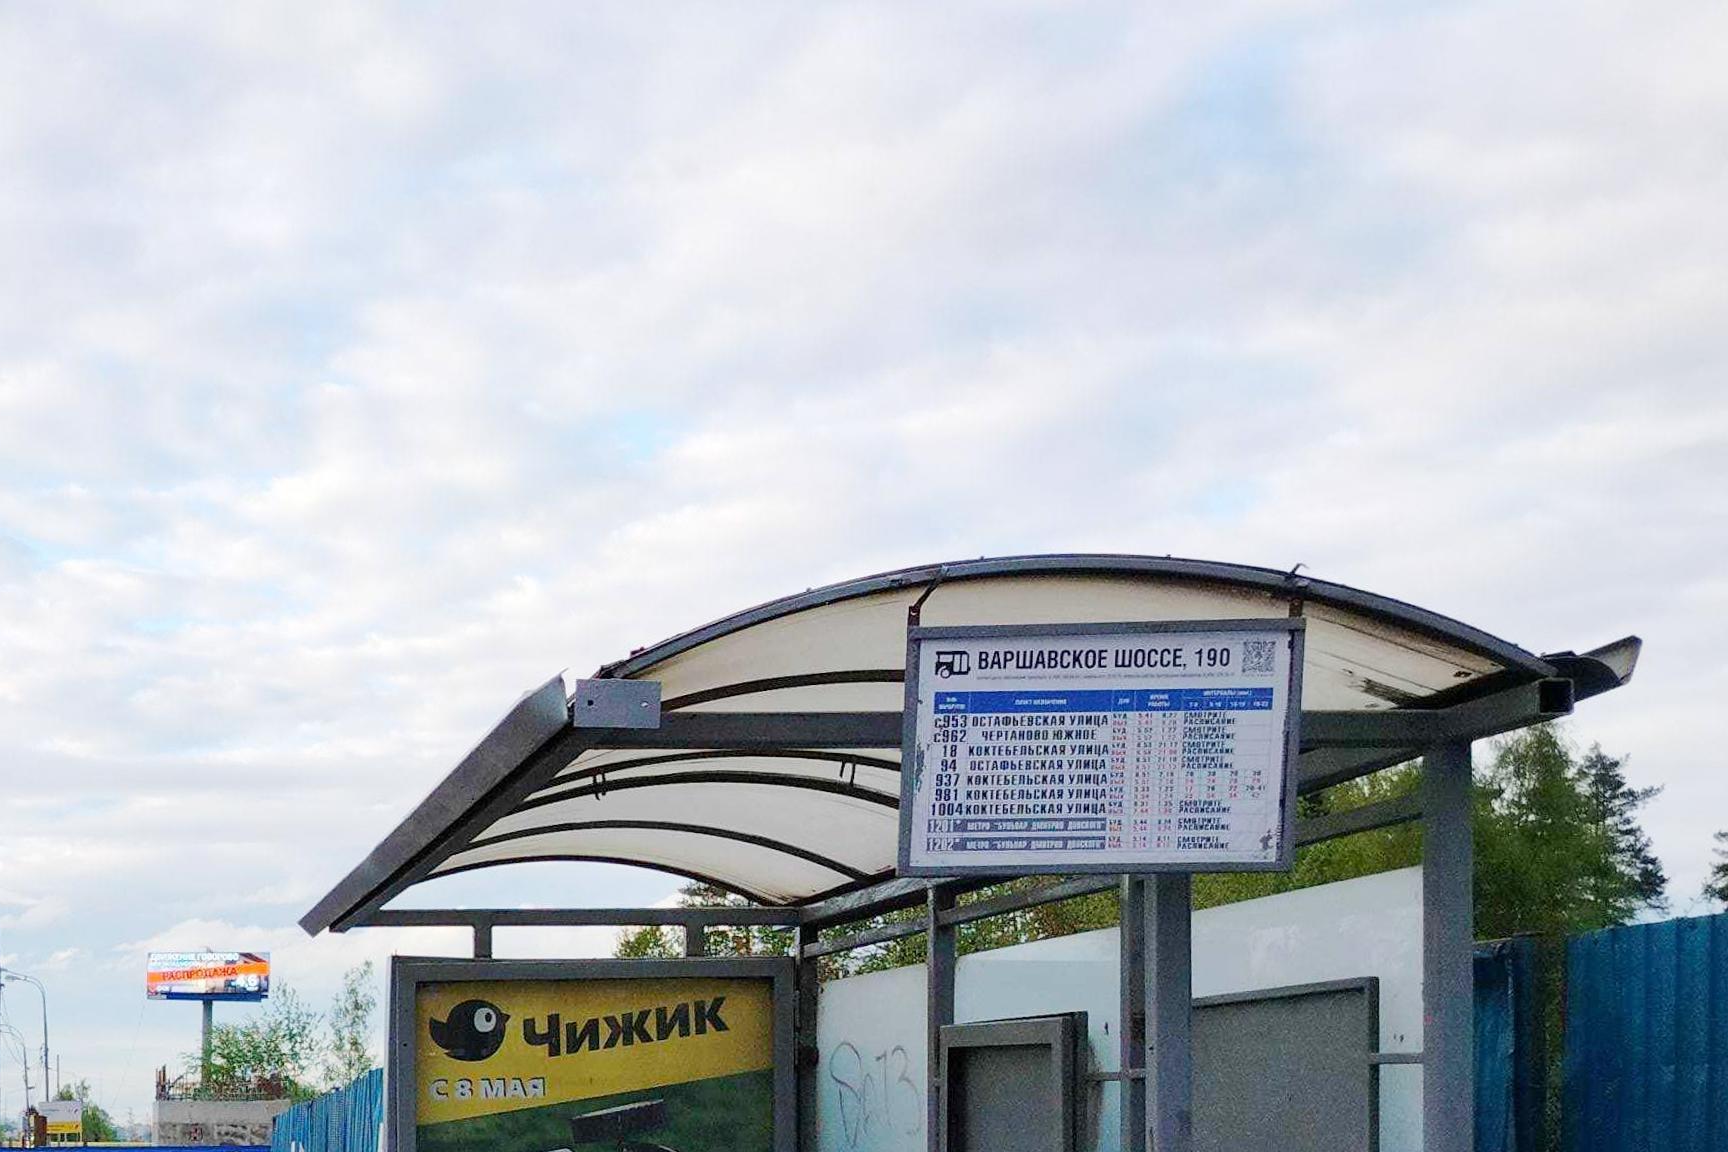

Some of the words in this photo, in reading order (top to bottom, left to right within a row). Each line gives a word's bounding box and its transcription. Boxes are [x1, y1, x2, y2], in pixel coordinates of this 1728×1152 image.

[978, 649, 1108, 670] ВАРШАВСКОЕ
[1114, 648, 1187, 669] ШОССЕ,
[1195, 648, 1231, 667] 190
[972, 715, 1065, 727] ОСТАФЬЕВСКАЯ
[1067, 714, 1108, 727] УЛИЦА
[982, 730, 1049, 741] ЧЕРТАНОВО
[1052, 729, 1097, 741] ЮЖНОЕ
[942, 744, 957, 758] 18
[969, 745, 1066, 757] КОКТЕБЕЛЬСКАЯ
[1067, 744, 1109, 757] УЛИЦА
[940, 759, 957, 772] 94
[970, 759, 1064, 771] ОСТАФЬЕВСКАЯ
[1067, 759, 1106, 771] УЛИЦА
[935, 773, 960, 787] 937
[967, 774, 1064, 786] КОКТЕБЕЛЬСКАЯ
[1066, 773, 1108, 785] УЛИЦА
[935, 788, 958, 801] 981
[966, 789, 1063, 800] КОКТЕБЕЛЬСКАЯ
[1067, 788, 1107, 800] УЛИЦА
[931, 803, 963, 816] 1004
[965, 803, 1062, 815] КОКТЕБЕЛЬСКАЯ
[1066, 803, 1106, 814] УЛИЦА
[429, 1079, 449, 1100] С
[454, 1079, 473, 1099] 8
[481, 1077, 546, 1099] МАЯ
